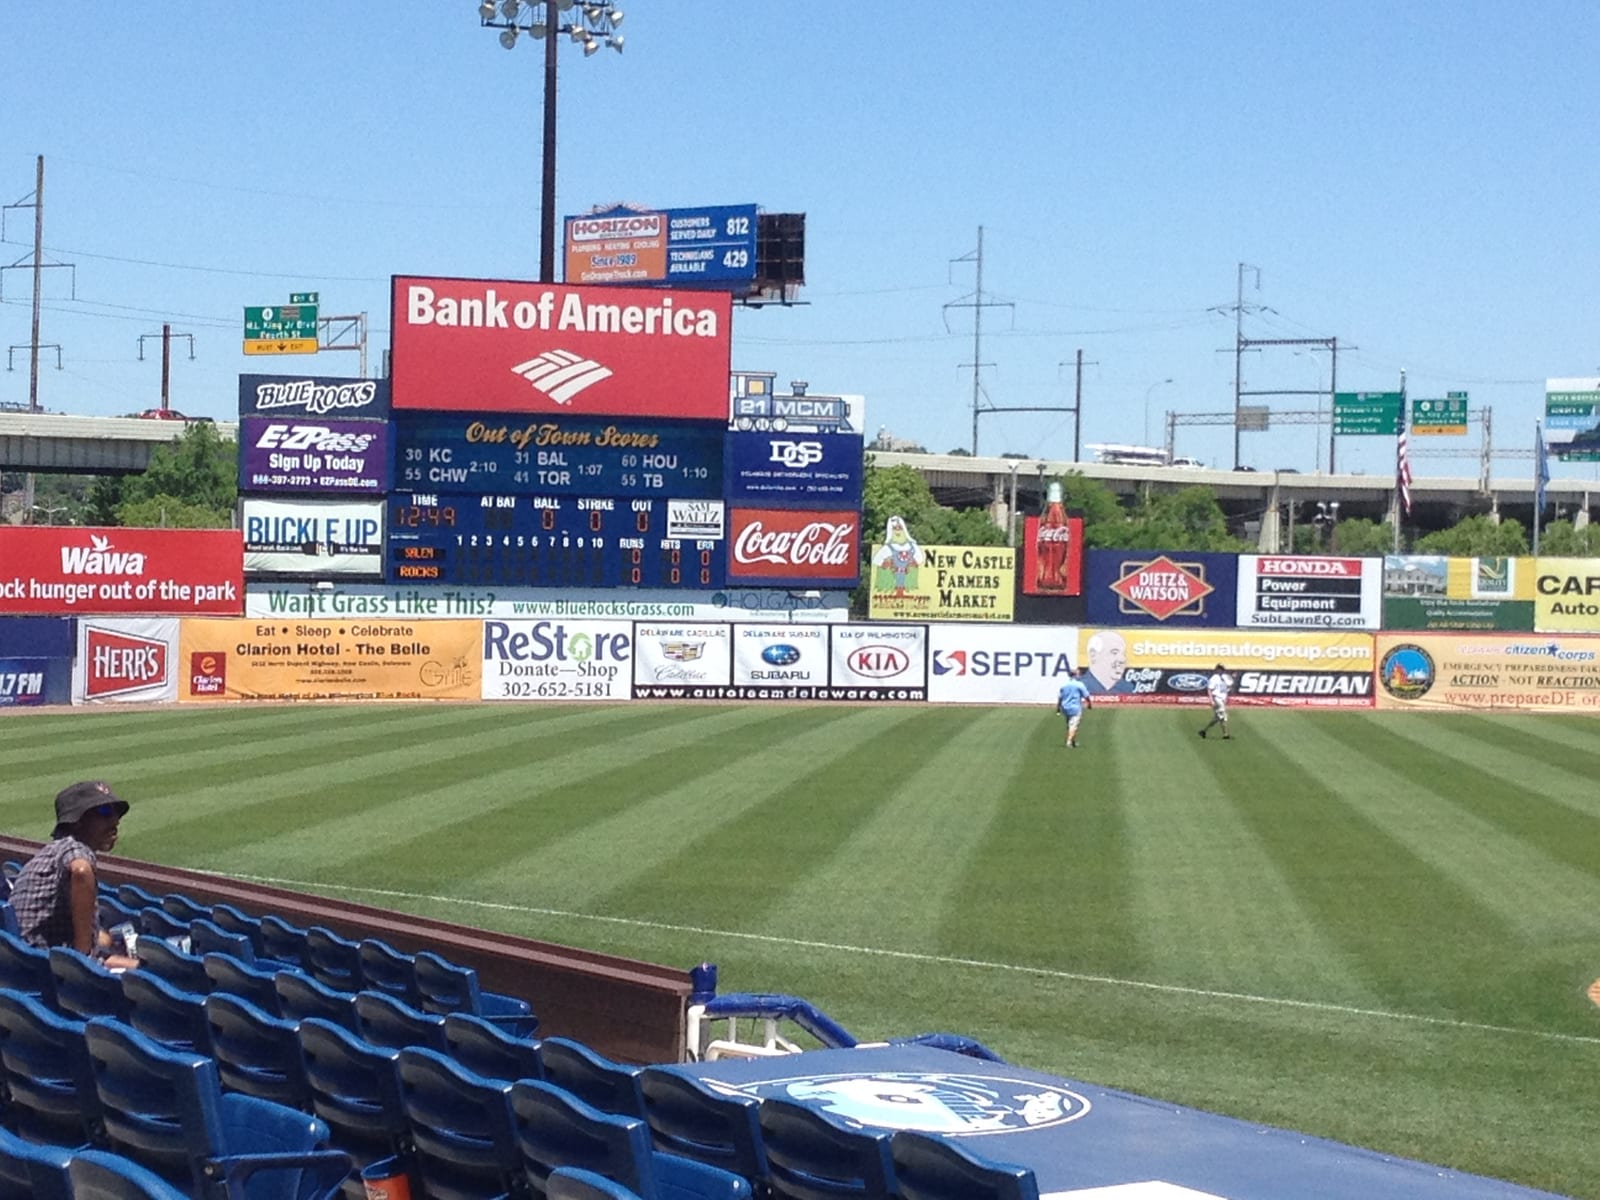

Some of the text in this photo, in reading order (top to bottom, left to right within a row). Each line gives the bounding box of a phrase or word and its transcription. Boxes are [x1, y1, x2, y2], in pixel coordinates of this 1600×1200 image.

[574, 217, 658, 235] HORIZON
[726, 217, 749, 236] 812
[723, 250, 748, 268] 429
[407, 286, 718, 337] Bank of America
[740, 400, 833, 416] 21 MCM
[465, 422, 659, 449] Out of Town Scores
[269, 453, 365, 473] Sign Up Today
[405, 448, 453, 463] 30 KC
[514, 452, 568, 466] 31 BAL
[643, 455, 678, 469] HOU
[469, 461, 497, 473] 2:10
[577, 465, 603, 476] 1:07
[682, 467, 708, 479] 1:10
[405, 468, 468, 483] 55 CHW
[514, 471, 571, 485] 41 TOR
[643, 473, 664, 488] TB
[412, 494, 438, 506] TIME
[480, 496, 516, 508] AT BAT
[533, 497, 561, 509] BALL
[577, 499, 615, 510] STRIKE
[631, 500, 652, 512] OUT
[399, 507, 456, 527] 12:49
[542, 509, 554, 531] 0
[590, 511, 601, 532] 0
[637, 511, 648, 532] 0
[346, 518, 378, 544] UP
[456, 535, 604, 548] 1 2 3 4 5 6 7 8 9 10
[620, 538, 644, 549] RUNS
[734, 521, 854, 565] Coca-Cola
[61, 546, 144, 575] Wawa
[404, 548, 710, 566] SALEM 0 0 0
[924, 549, 1014, 570] NEW CASTLE
[400, 565, 710, 584] ROCKS 0 0 0
[1262, 560, 1347, 574] HONDA
[936, 570, 1000, 589] FARMERS
[1140, 573, 1188, 586] DIETZ &
[1262, 579, 1306, 591] Power
[29, 579, 96, 604] hunger
[100, 581, 132, 599] out
[136, 580, 158, 599] of
[159, 581, 191, 600] the
[195, 581, 236, 605] park
[939, 590, 997, 609] MARKET
[1129, 586, 1189, 600] WATSON
[268, 590, 495, 615] Want Grass Like This?
[513, 599, 694, 616] www.BlueRocksGrass.com
[1262, 597, 1335, 610] Equipment
[1550, 602, 1599, 616] Auto
[1251, 614, 1366, 627] SubLawnEQ.com
[256, 625, 413, 638] Eat Sleep Celebrate
[484, 621, 630, 661] ReStore
[236, 643, 431, 655] Clarion Hotel The Belle
[1505, 644, 1546, 655] citizen
[1558, 650, 1595, 661] corps
[94, 646, 159, 681] HERR'S
[858, 653, 899, 671] KIA
[971, 651, 1072, 677] SEPTA
[750, 671, 810, 680] SUBARU
[1451, 674, 1499, 686] ACTION
[1508, 675, 1534, 685] NOT
[17, 672, 43, 695] FM
[502, 682, 611, 697] 302-652-5181
[1238, 672, 1371, 695] SHERIDAN
[635, 687, 924, 699] www.autoteamdelaware.com
